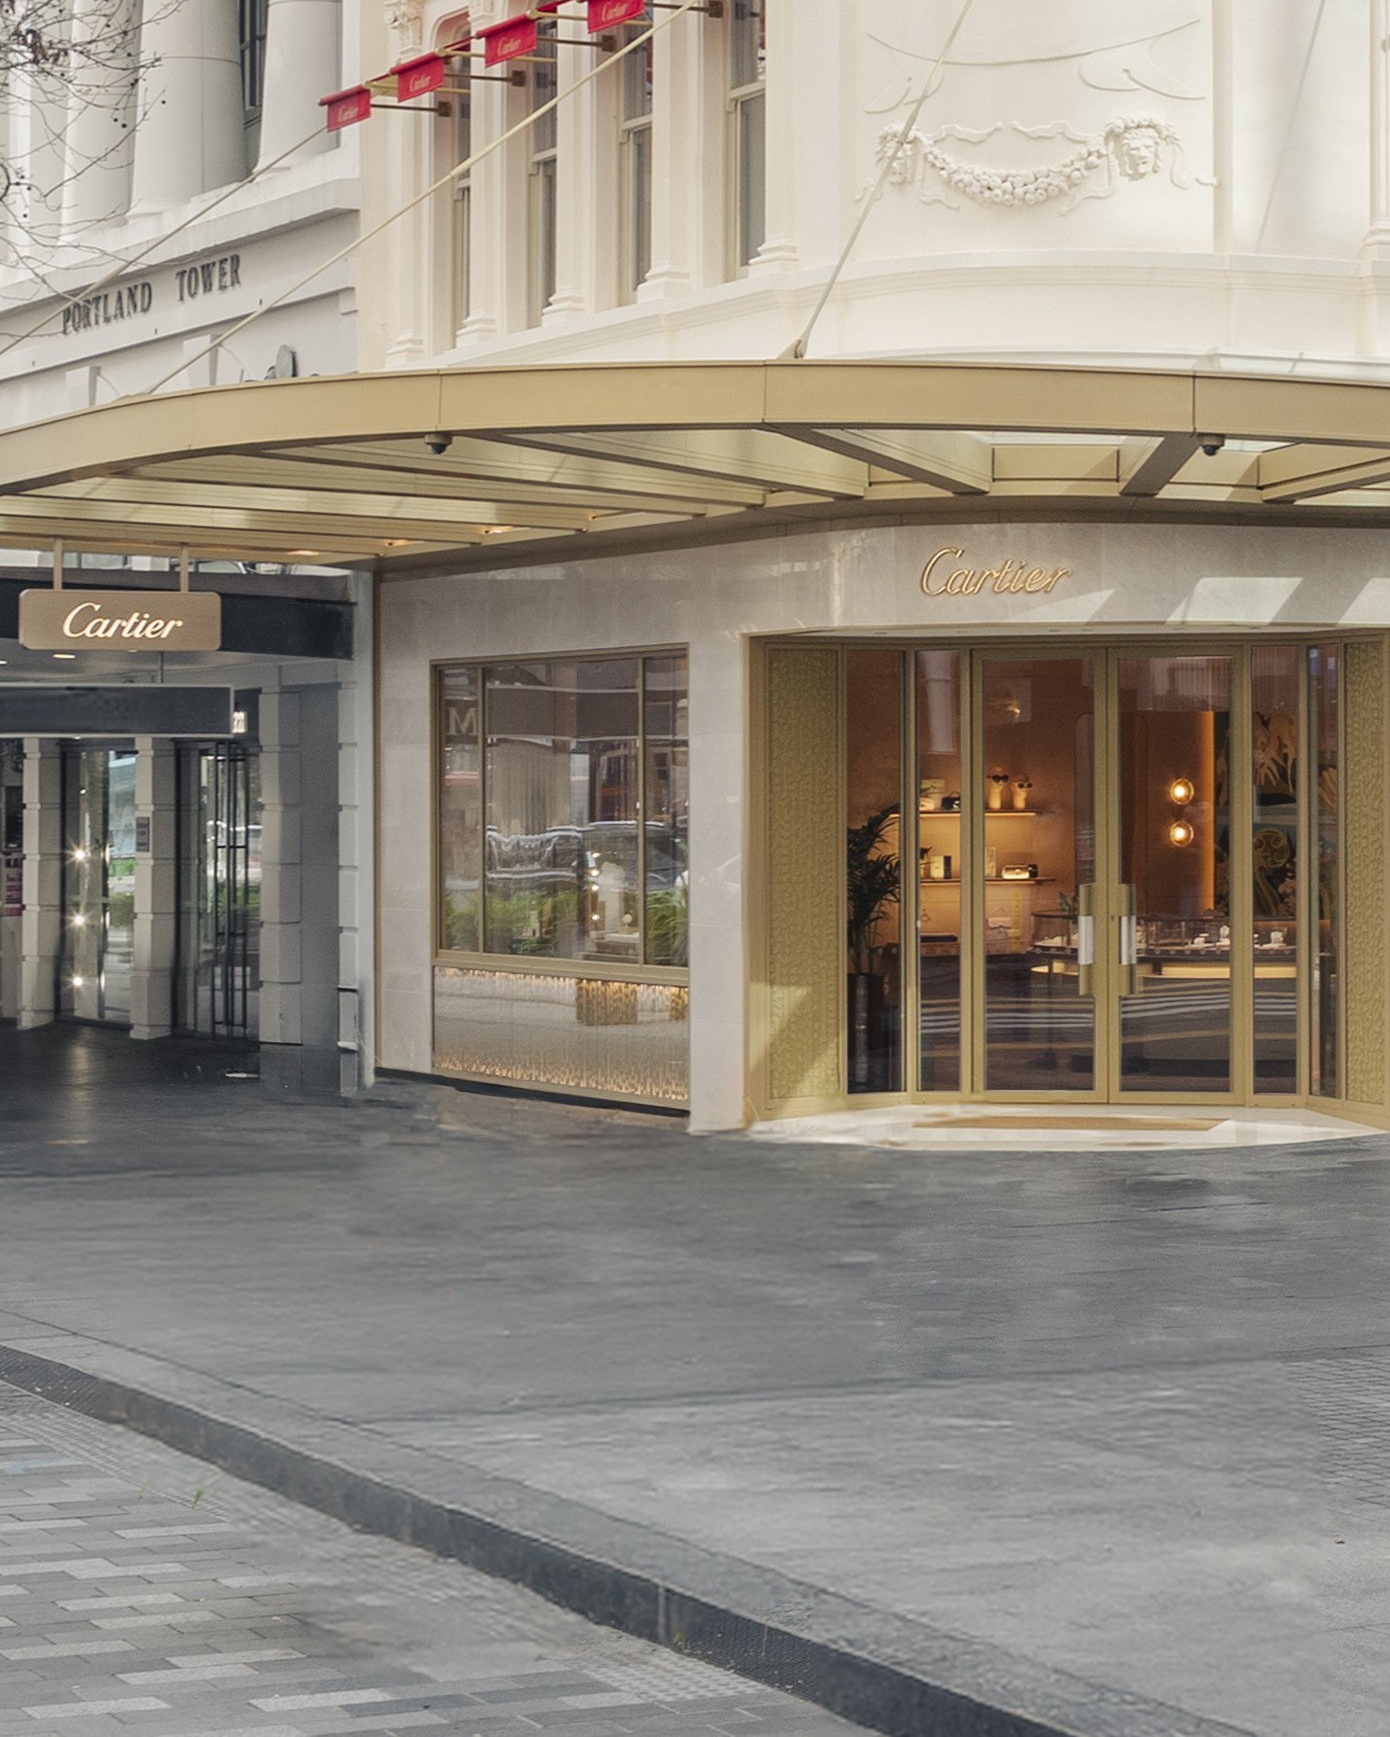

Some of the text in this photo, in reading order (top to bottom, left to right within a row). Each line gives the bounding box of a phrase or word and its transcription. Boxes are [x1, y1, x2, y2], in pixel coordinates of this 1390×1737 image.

[62, 253, 241, 336] PORTLAND TOWER
[920, 546, 1073, 597] Cartier
[62, 601, 184, 639] Cartier
